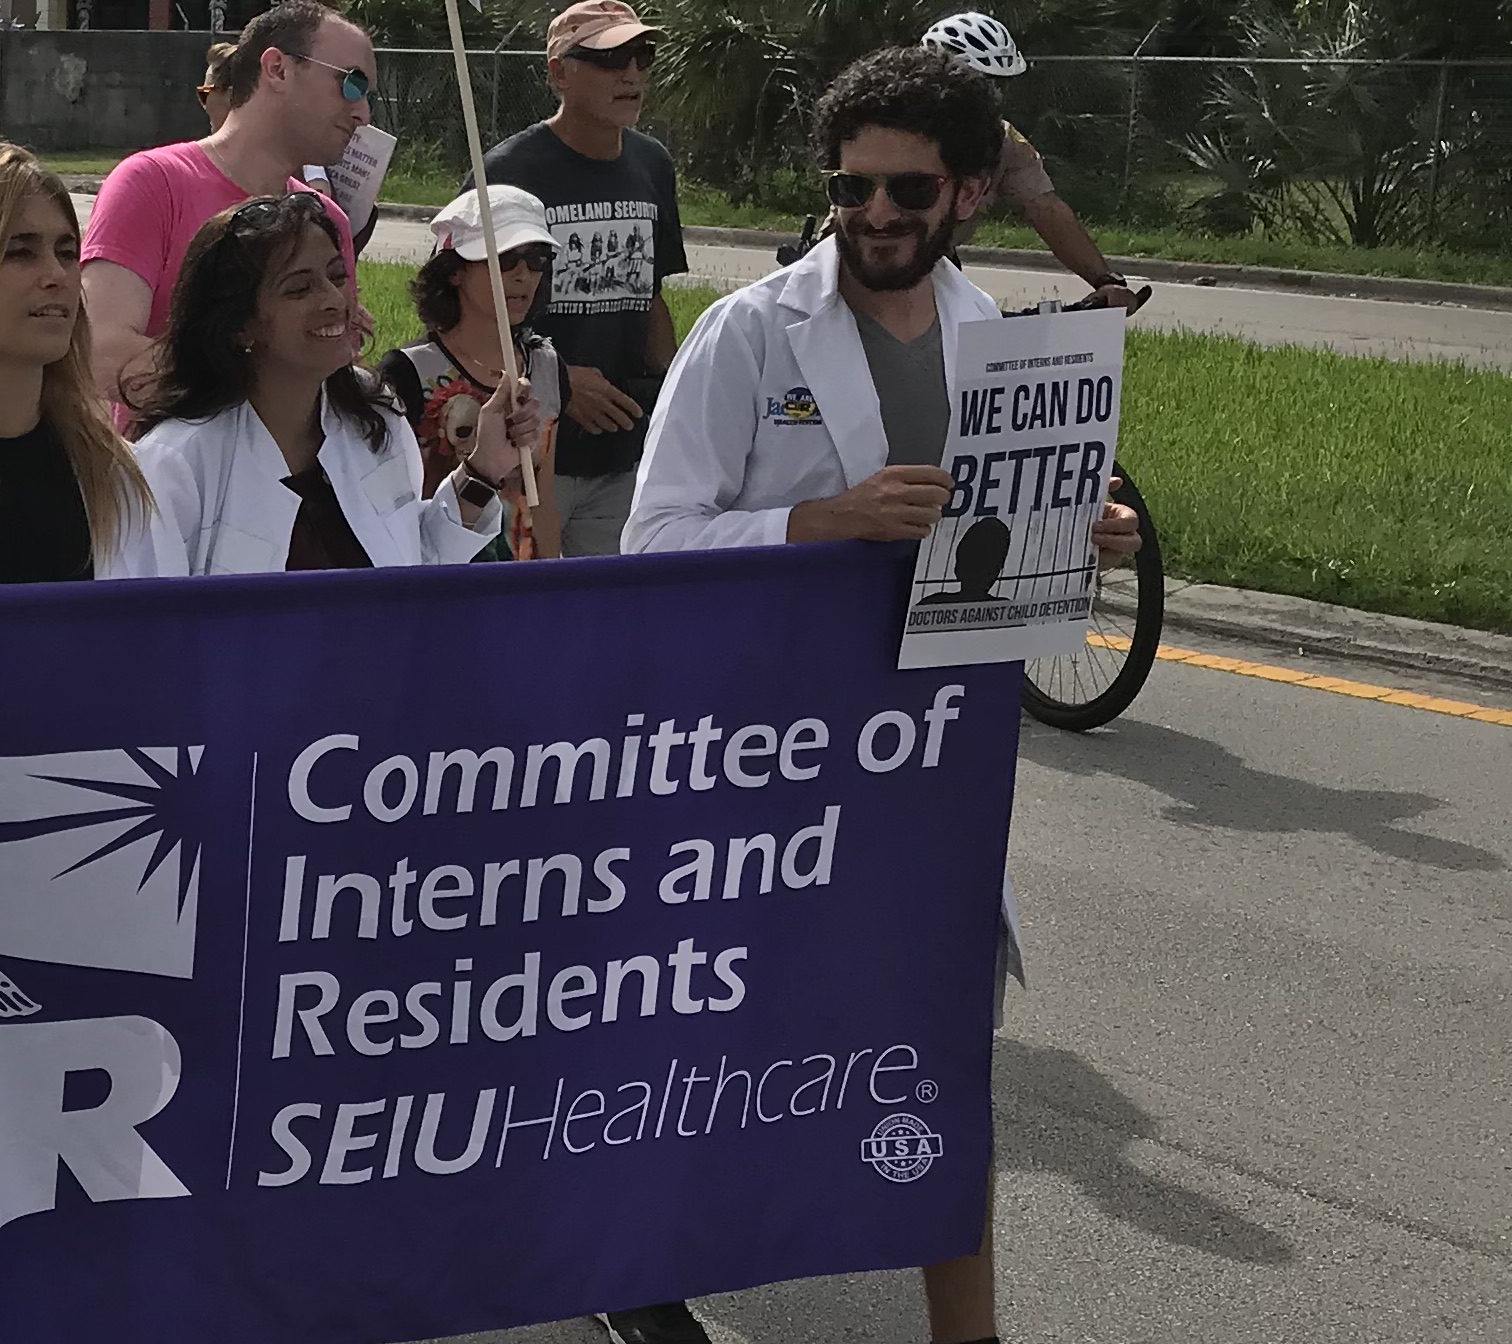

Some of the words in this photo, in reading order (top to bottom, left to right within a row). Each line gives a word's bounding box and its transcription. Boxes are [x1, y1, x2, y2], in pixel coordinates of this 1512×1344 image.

[959, 386, 1006, 437] WE
[1011, 380, 1069, 432] CAN
[1075, 375, 1113, 425] DO
[941, 440, 1107, 518] BETTER
[908, 608, 957, 627] DOCTORS
[959, 606, 1005, 623] AGAINST
[1008, 603, 1037, 620] CHILD
[1039, 596, 1090, 617] DETENTION
[287, 712, 830, 824] Committee
[856, 684, 965, 774] of
[277, 844, 631, 944] Interns
[658, 805, 842, 905] and
[271, 937, 749, 1060] Residents
[871, 1138, 932, 1158] USA
[876, 1117, 901, 1136] UNION
[901, 1116, 925, 1133] MADE
[879, 1163, 891, 1175] IN
[892, 1170, 909, 1179] THE
[911, 1157, 929, 1177] USA
